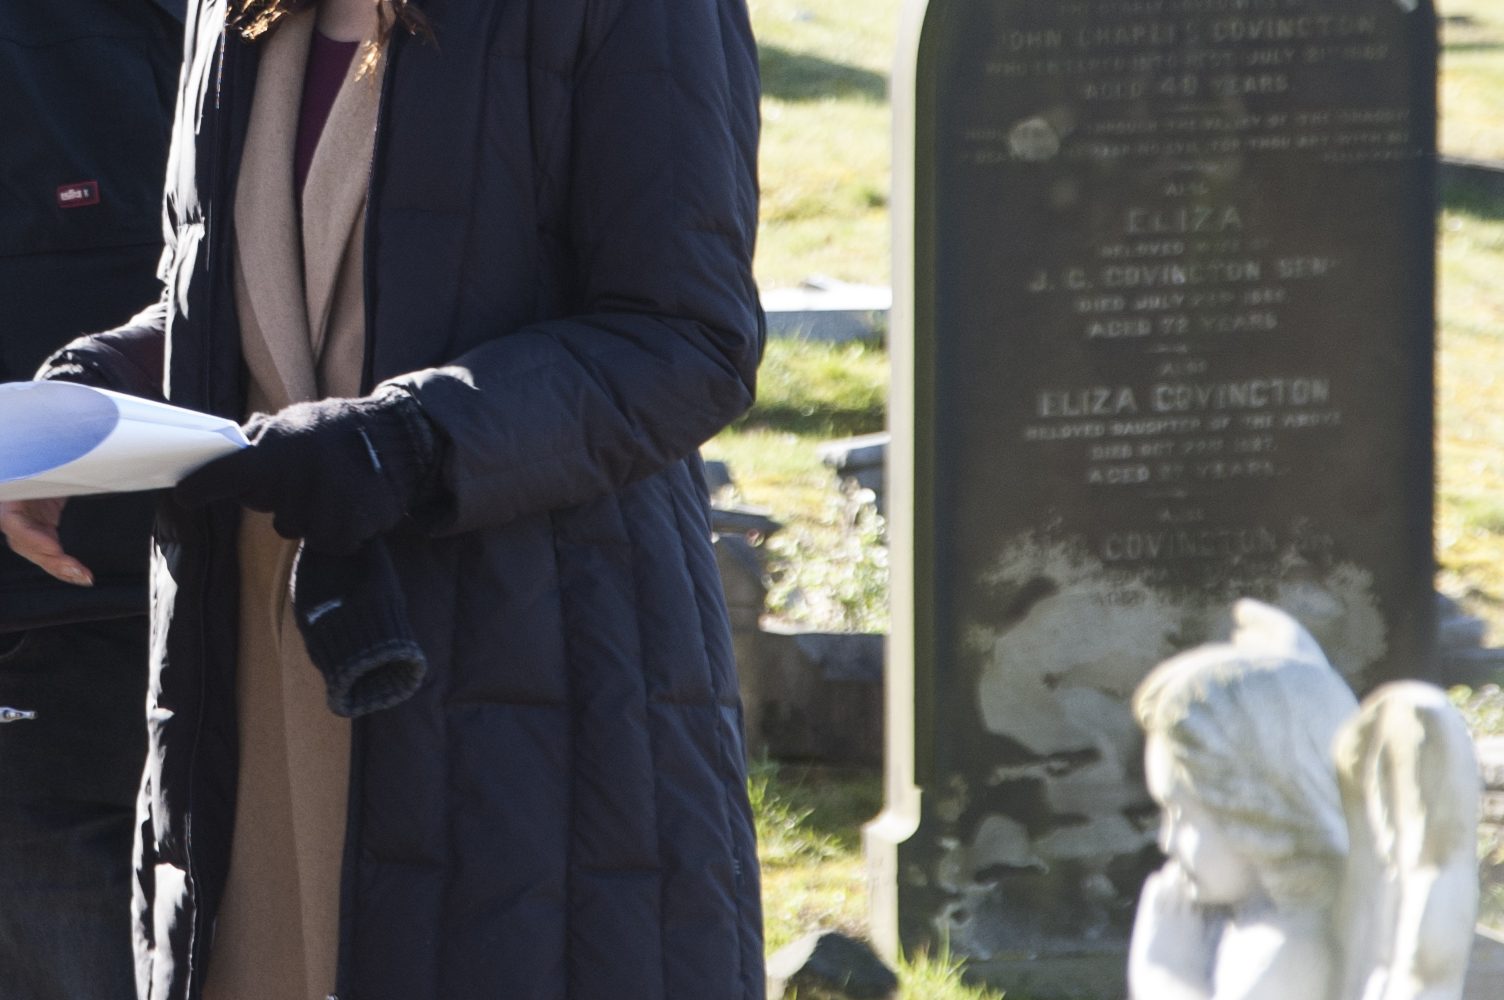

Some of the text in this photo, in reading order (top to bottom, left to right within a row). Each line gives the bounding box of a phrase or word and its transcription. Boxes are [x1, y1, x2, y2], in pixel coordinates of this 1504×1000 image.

[1001, 26, 1063, 51] JOHN
[1212, 13, 1378, 42] COVINGTON
[1247, 48, 1296, 67] JULY
[1211, 71, 1291, 95] YEARS
[1124, 204, 1245, 235] ELIZA
[1102, 259, 1262, 288] COVINGTON
[1132, 292, 1186, 312] JULY
[1085, 318, 1152, 340] AGED
[1198, 311, 1280, 334] YEARS
[1037, 376, 1332, 418] ELIZA COVINGTON
[1022, 422, 1106, 442] BELOVED
[1085, 465, 1152, 485] AGED
[1102, 527, 1279, 562] COVINGTON
